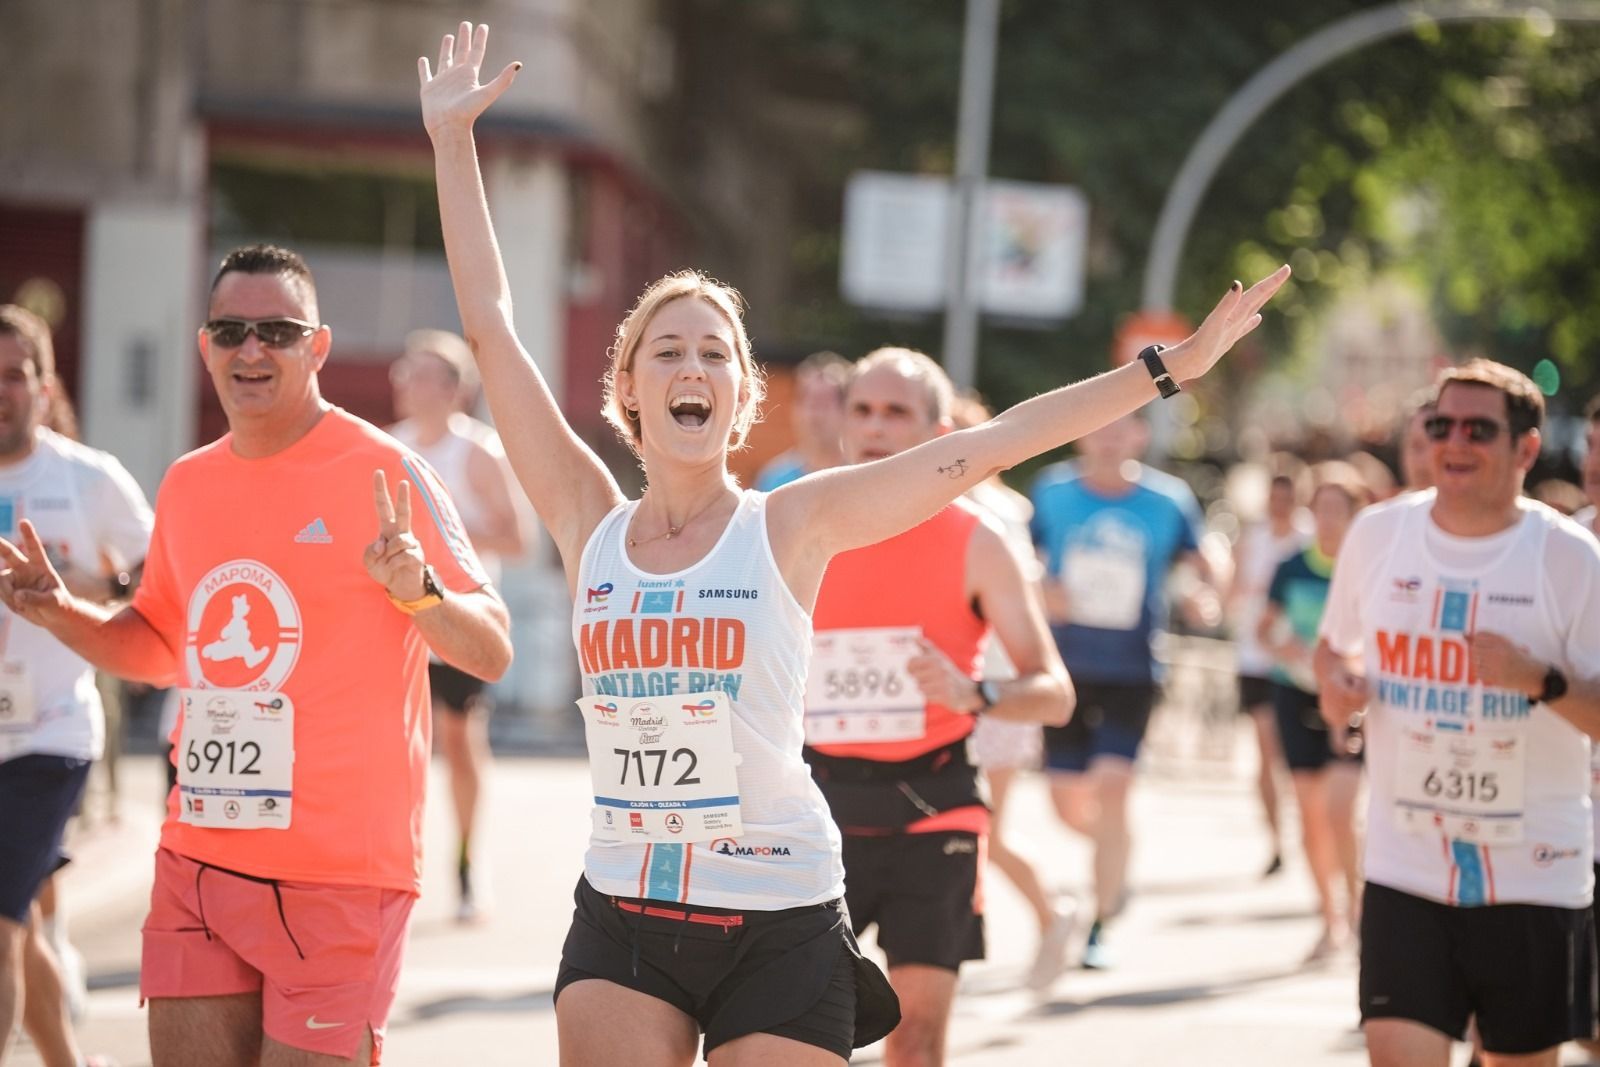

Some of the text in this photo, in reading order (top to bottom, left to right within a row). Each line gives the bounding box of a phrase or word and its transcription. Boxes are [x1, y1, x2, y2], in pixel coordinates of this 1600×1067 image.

[204, 567, 273, 593] MAPOMA
[637, 579, 673, 588] luanvi
[698, 589, 758, 599] SAMSUNG
[580, 617, 746, 674] MADRID
[825, 669, 903, 700] 5896
[1378, 679, 1473, 717] VINTAGE
[630, 716, 663, 726] Madrid
[186, 739, 261, 775] 6912
[614, 747, 700, 787] 7172
[1423, 768, 1498, 801] 6315
[735, 846, 791, 857] MAPOMA
